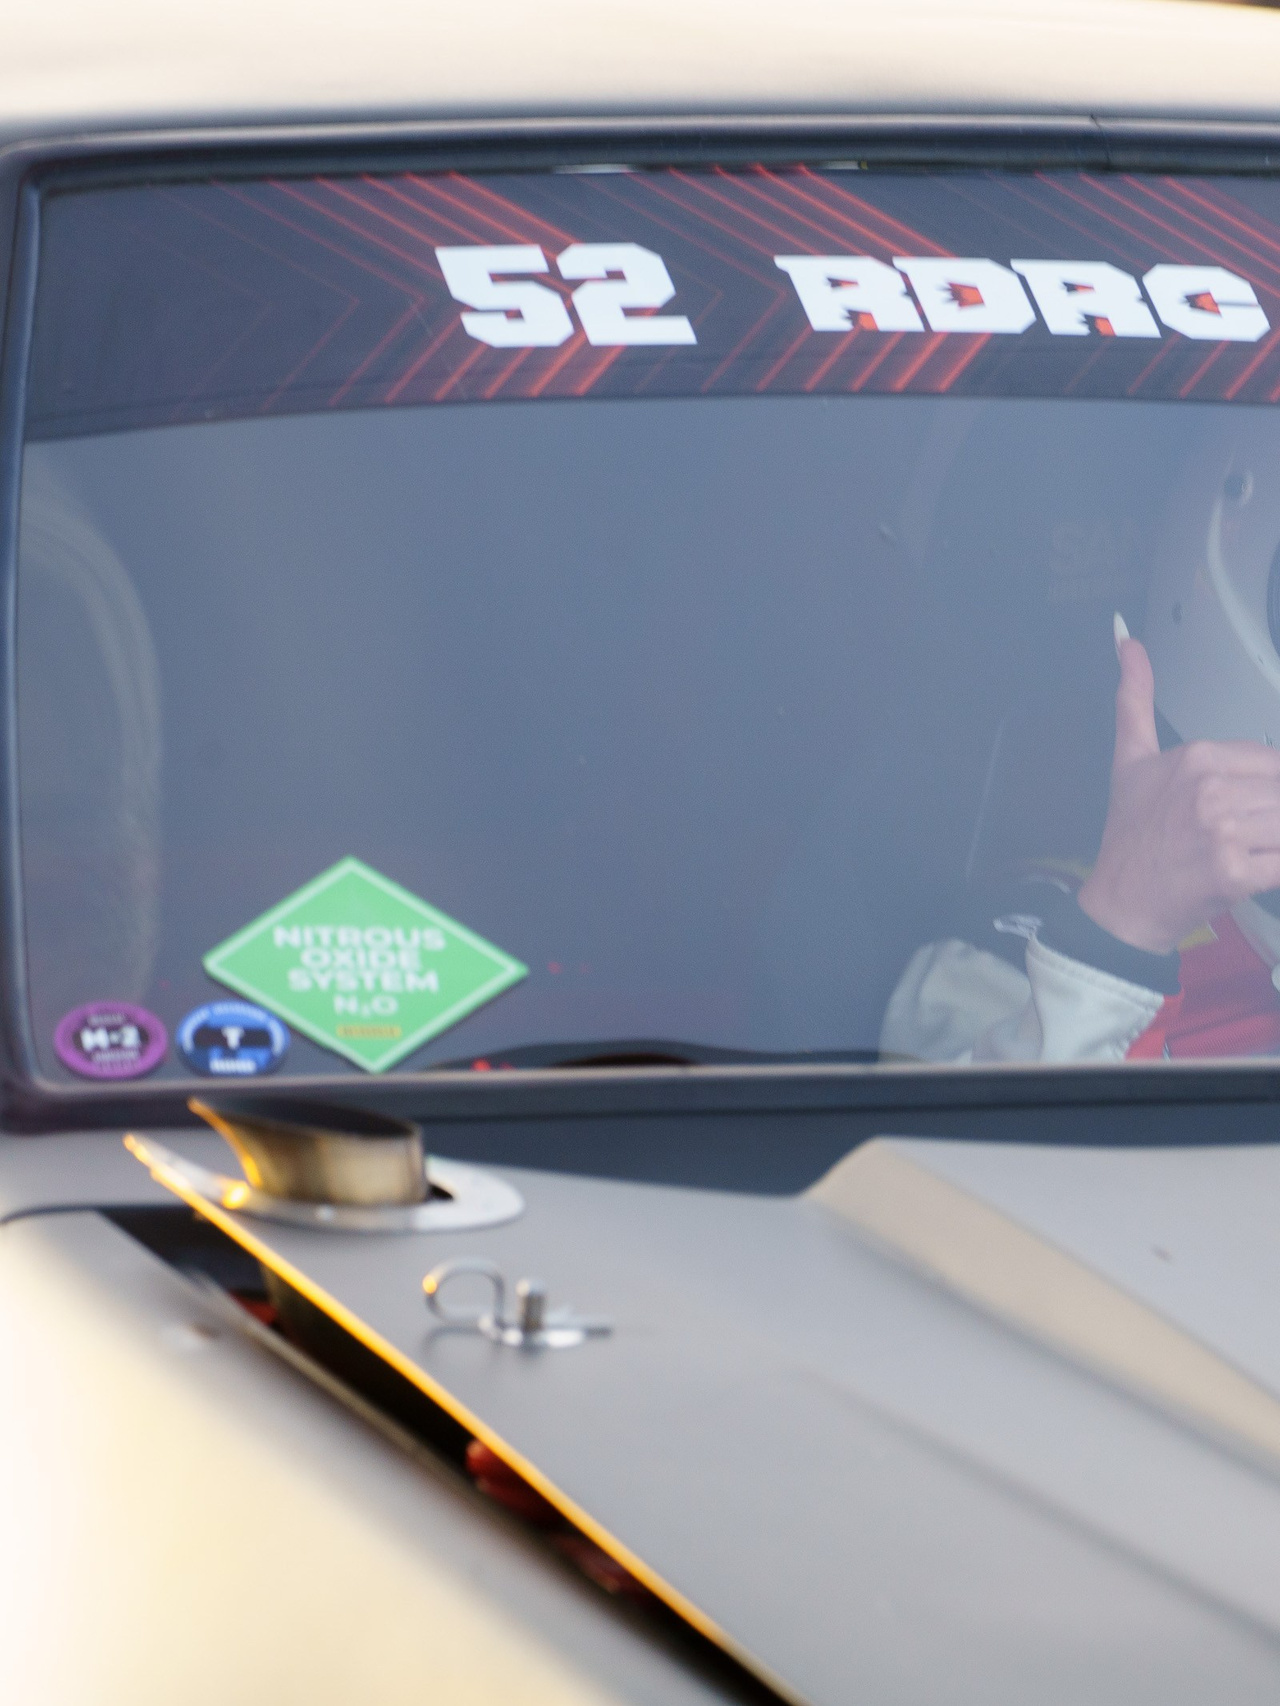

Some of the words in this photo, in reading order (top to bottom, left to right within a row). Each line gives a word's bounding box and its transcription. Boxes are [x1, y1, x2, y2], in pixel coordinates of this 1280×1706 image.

[435, 243, 698, 348] 52
[774, 255, 1271, 342] RDRC
[273, 925, 446, 950] NITROUS
[300, 947, 422, 971] OXIDE
[287, 968, 439, 992] SYSTEM
